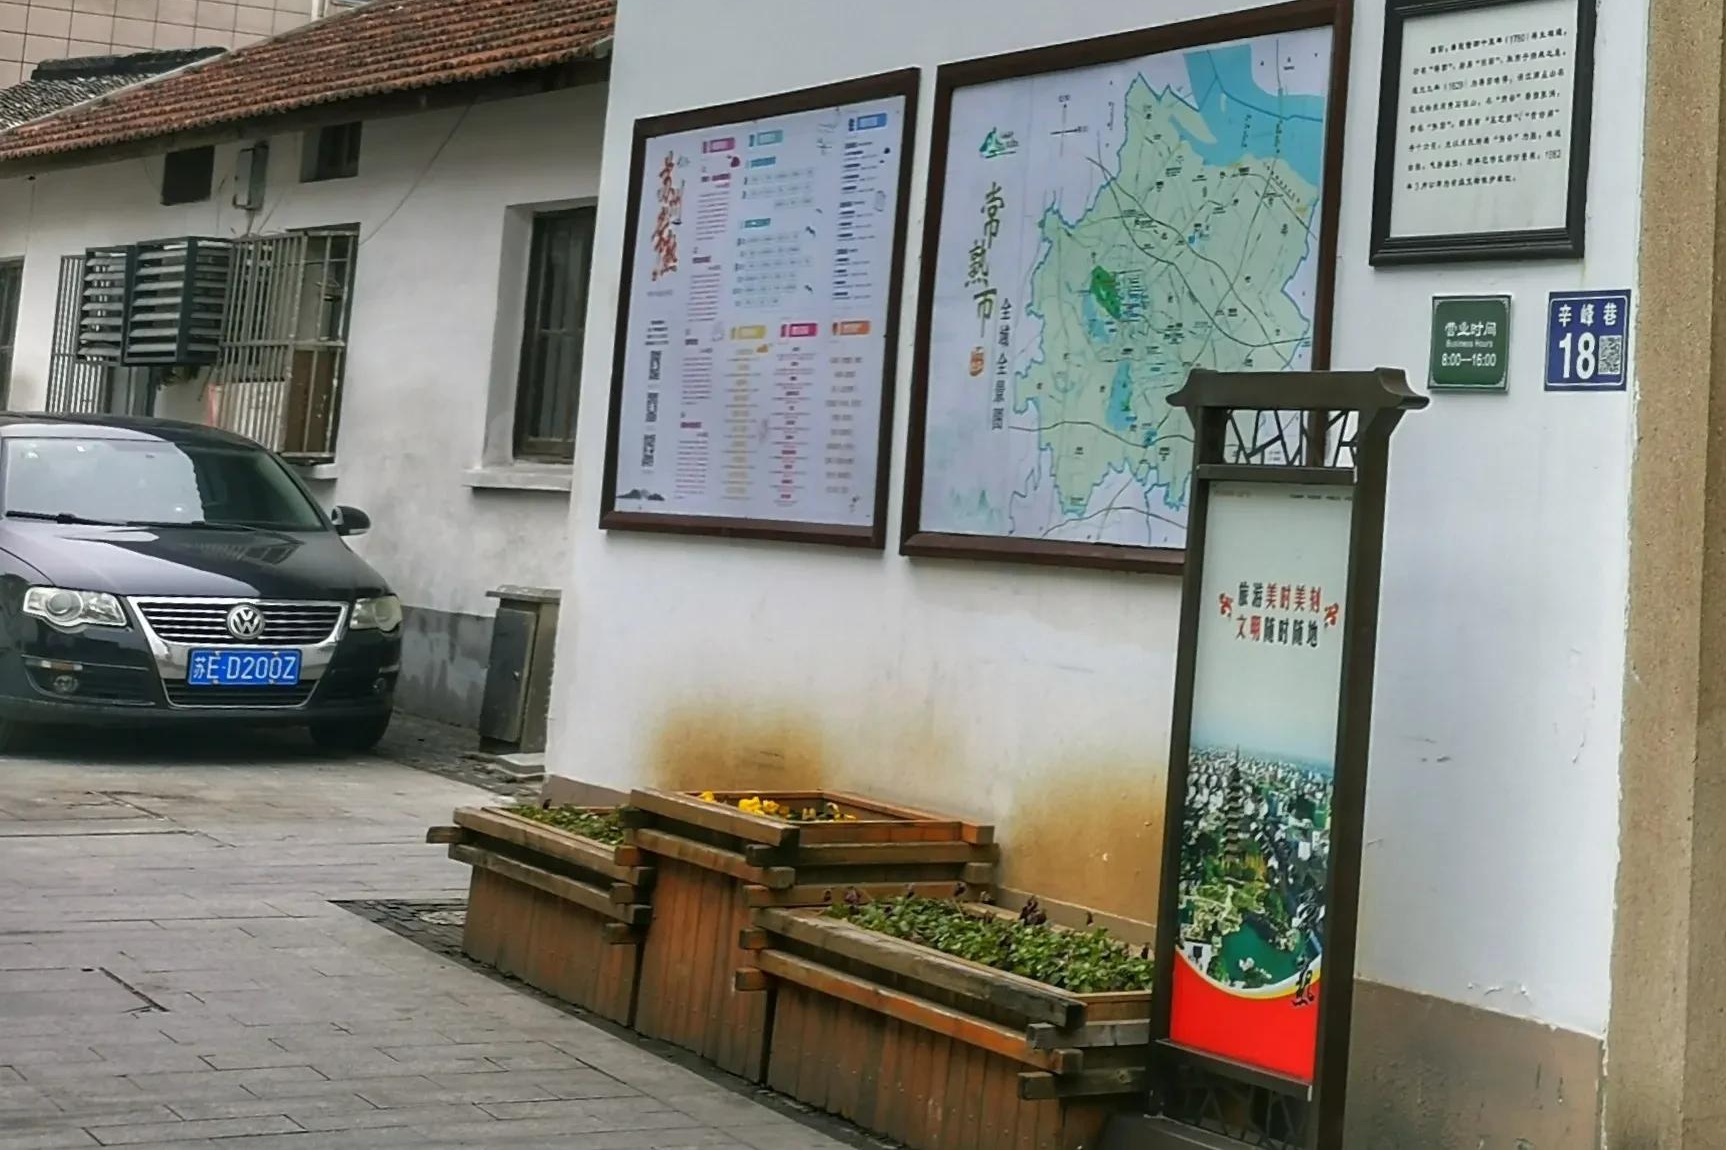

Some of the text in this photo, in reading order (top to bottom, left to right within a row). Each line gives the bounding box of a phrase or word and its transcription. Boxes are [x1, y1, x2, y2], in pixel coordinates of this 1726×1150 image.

[1558, 302, 1618, 327] 辛峰巷
[1558, 331, 1596, 380] 18
